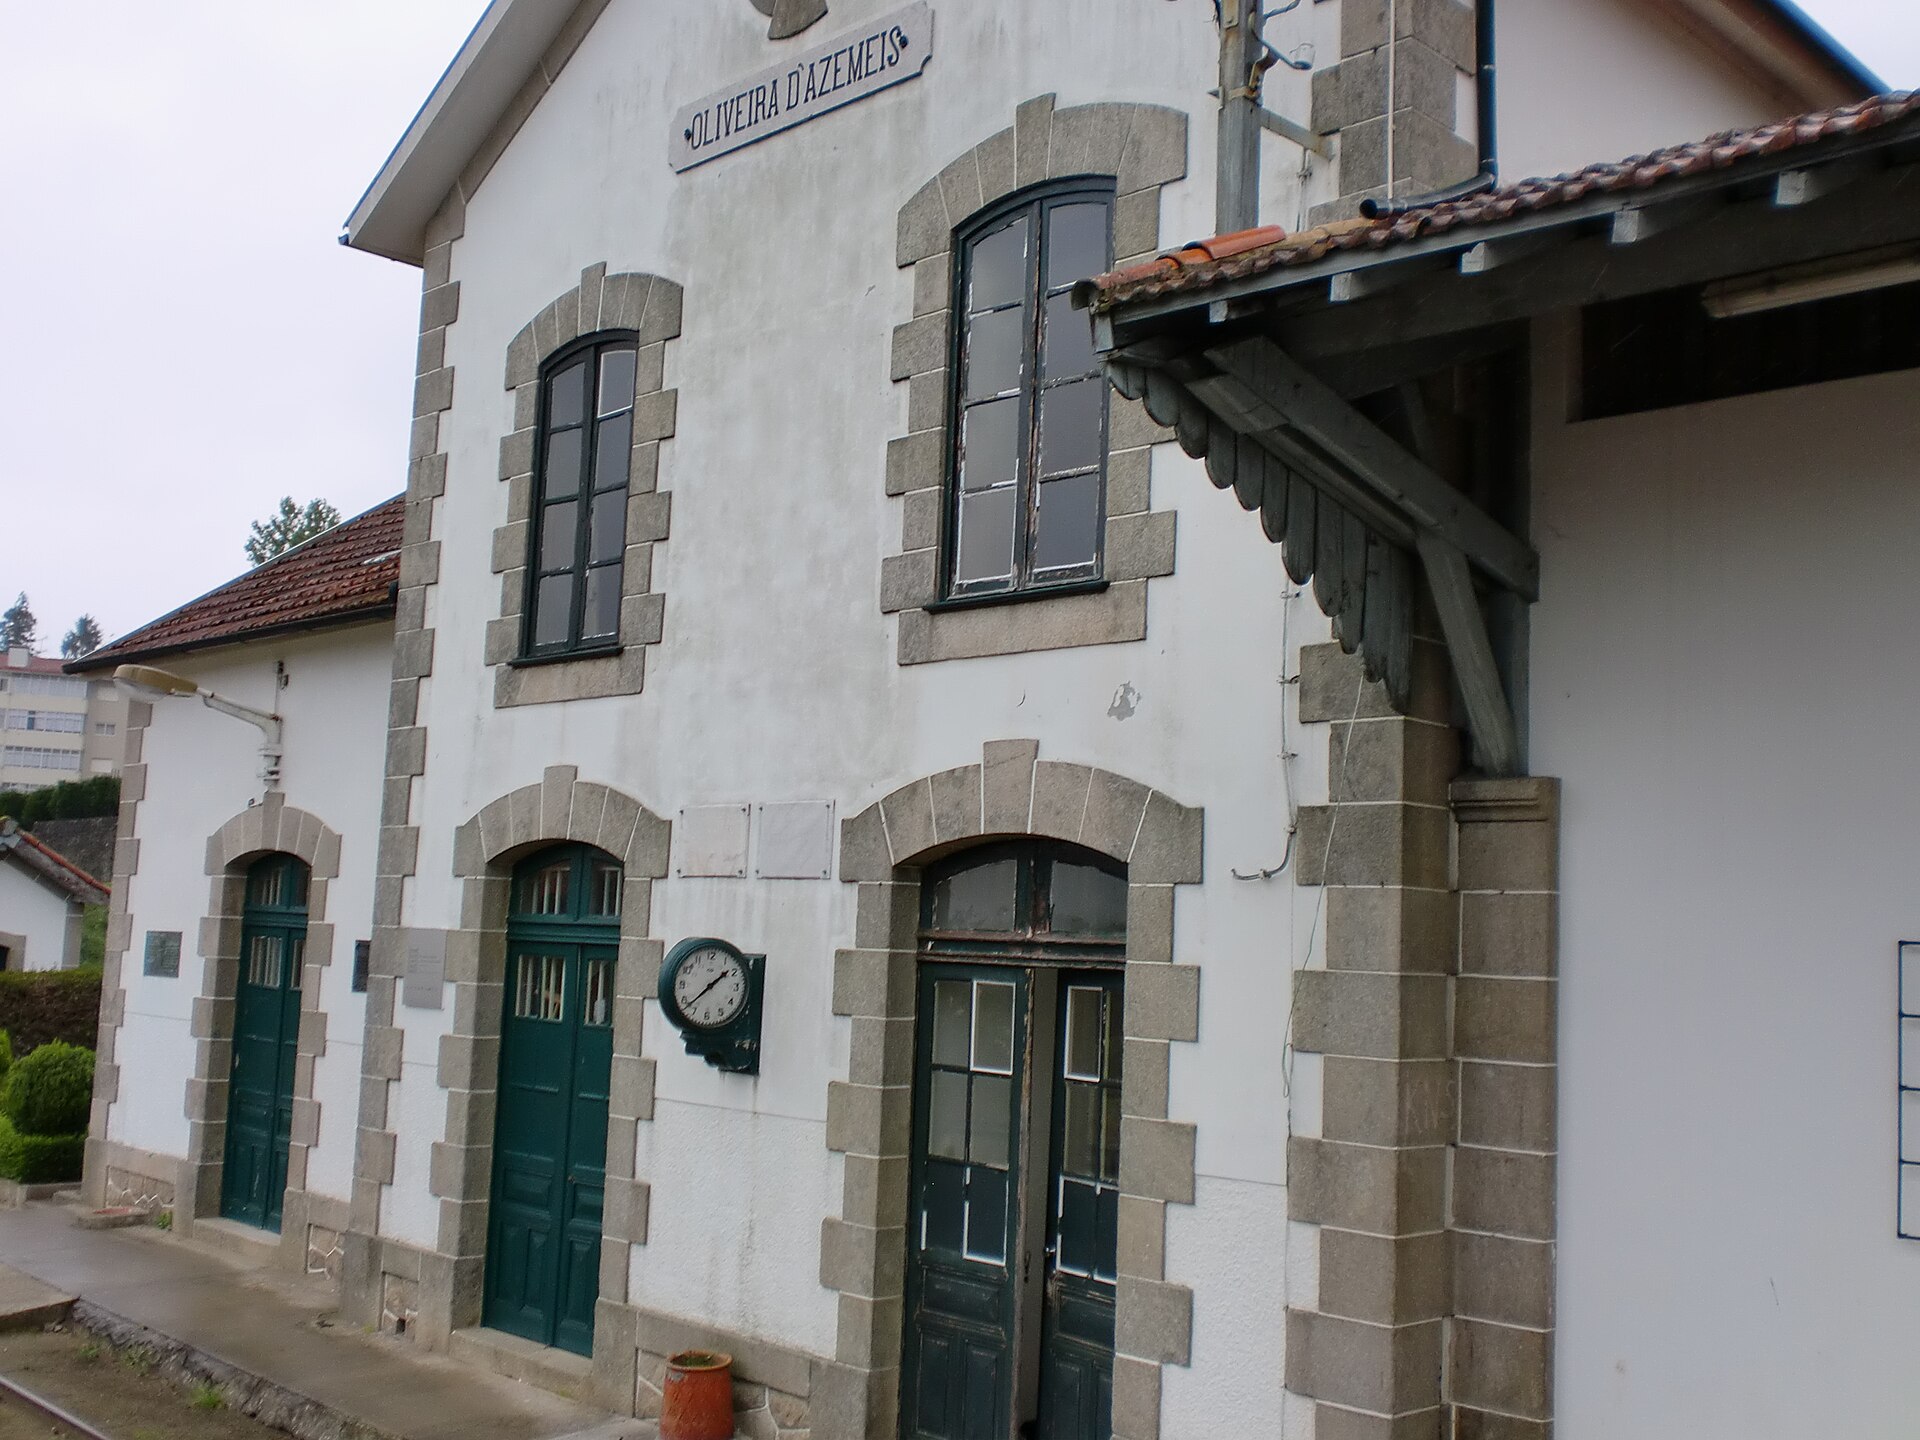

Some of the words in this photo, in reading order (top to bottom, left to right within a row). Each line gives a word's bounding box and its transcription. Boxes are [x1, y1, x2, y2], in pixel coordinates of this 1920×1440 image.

[690, 79, 780, 150] OLIVEIRA
[707, 951, 717, 961] 12
[723, 956, 728, 966] 1
[731, 967, 738, 977] 2
[733, 982, 740, 992] 3
[727, 997, 734, 1007] 4
[691, 1006, 698, 1016] 7
[703, 1011, 711, 1021] 6
[717, 1007, 724, 1017] 5
